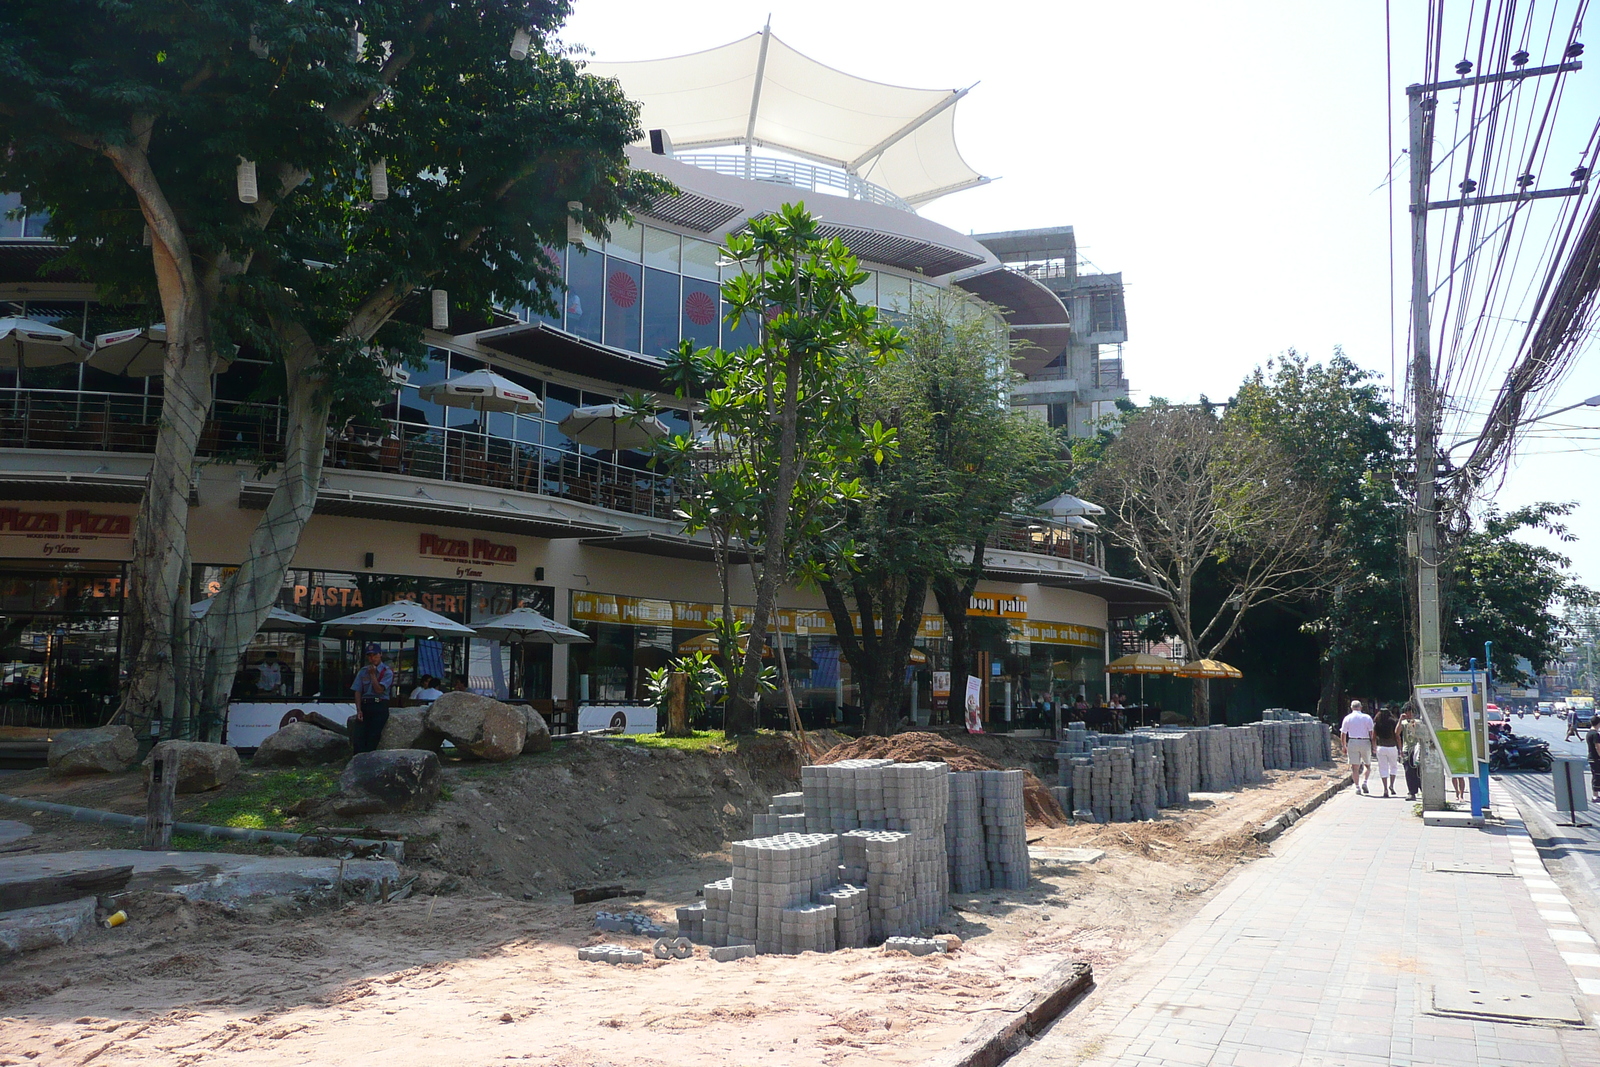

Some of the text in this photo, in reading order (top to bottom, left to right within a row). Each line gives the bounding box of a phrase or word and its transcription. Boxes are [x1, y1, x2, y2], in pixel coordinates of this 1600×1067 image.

[0, 508, 130, 534] Pizza Pizza
[43, 543, 54, 556] by
[420, 533, 517, 562] Pizza Pizza
[456, 567, 464, 578] by
[294, 585, 364, 608] PASTA
[969, 595, 1028, 615] bon pain
[577, 600, 591, 613] au
[596, 597, 618, 615] bon
[677, 604, 702, 621] bon
[1041, 626, 1057, 641] pain
